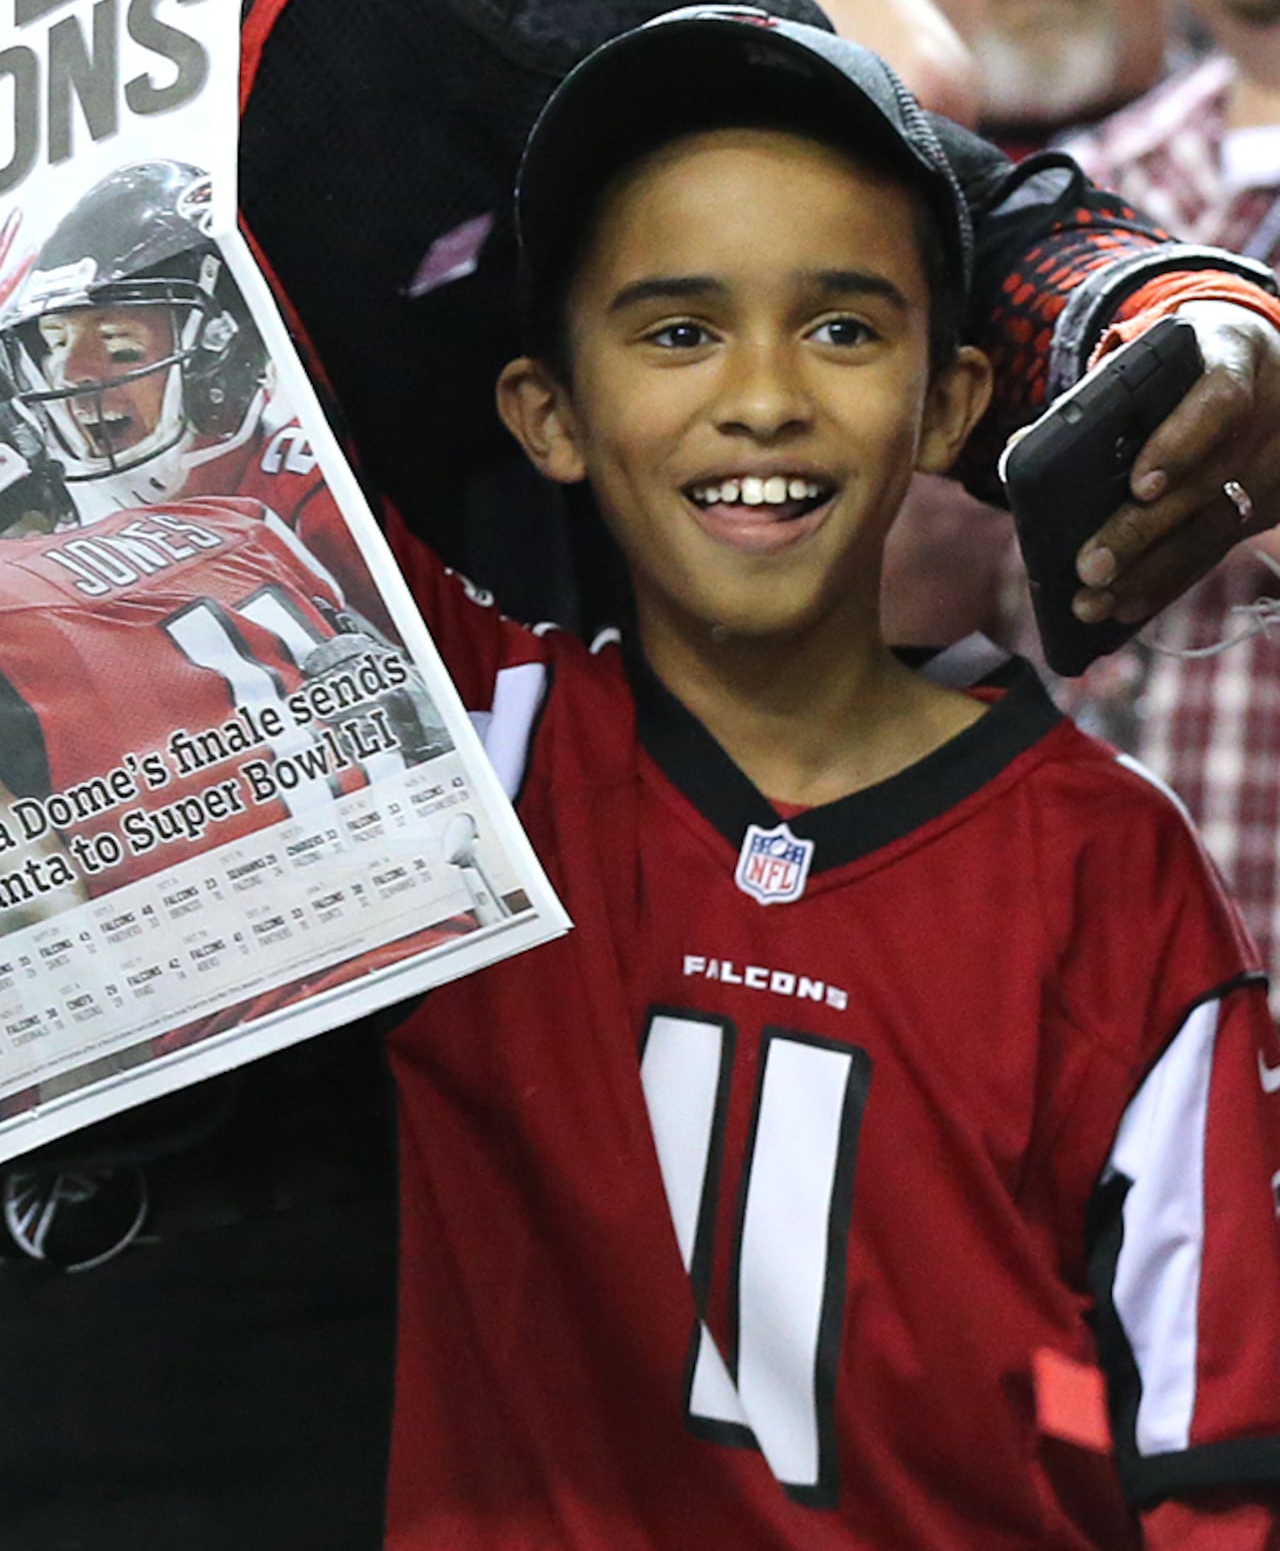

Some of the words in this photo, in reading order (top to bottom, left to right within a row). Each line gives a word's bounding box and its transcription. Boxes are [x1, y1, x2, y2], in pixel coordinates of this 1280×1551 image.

[42, 512, 223, 597] JONES
[169, 706, 285, 776] finale
[289, 653, 408, 727] sends
[72, 835, 121, 873] to
[123, 777, 244, 852] Super
[242, 731, 348, 803] Bowl
[345, 712, 399, 761] LI
[749, 856, 792, 890] NFL
[683, 955, 848, 1010] FALCONS
